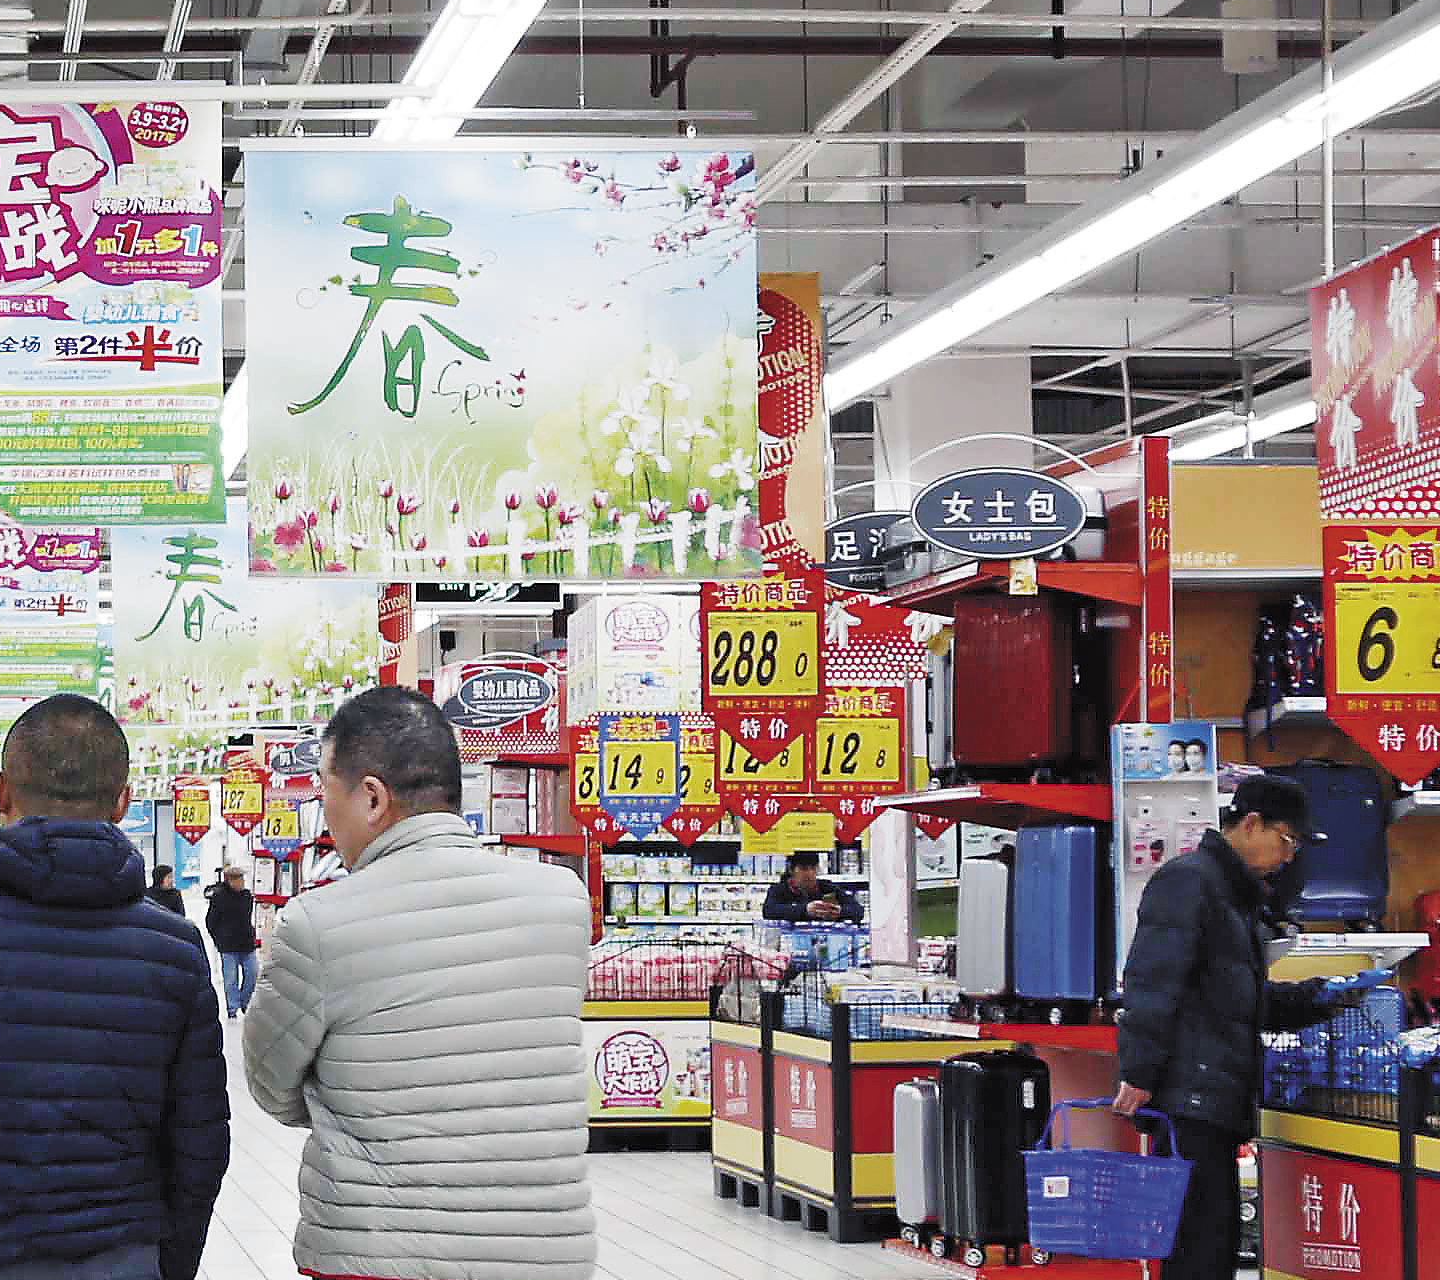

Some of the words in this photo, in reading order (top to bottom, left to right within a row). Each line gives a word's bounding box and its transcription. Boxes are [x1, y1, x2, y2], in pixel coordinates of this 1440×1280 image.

[135, 128, 177, 142] 2017年
[95, 219, 221, 258] 加1元多1件
[288, 195, 490, 417] 春
[55, 325, 203, 371] 第2件半价
[432, 360, 526, 425] Spring
[941, 490, 1057, 524] 女士包
[1147, 496, 1171, 551] 特价
[134, 528, 240, 642] 春
[719, 579, 807, 606] 特价商品
[710, 629, 779, 687] 288
[794, 652, 808, 678] 0
[1147, 630, 1171, 689] 特价
[1357, 606, 1399, 681] 6
[740, 718, 789, 741] 特价
[608, 753, 642, 791] 14
[822, 731, 861, 775] 12
[875, 749, 887, 769] 8
[671, 818, 702, 832] 特价
[743, 797, 780, 815] 特价
[839, 798, 879, 815] 特价
[1302, 1175, 1362, 1245] 特价
